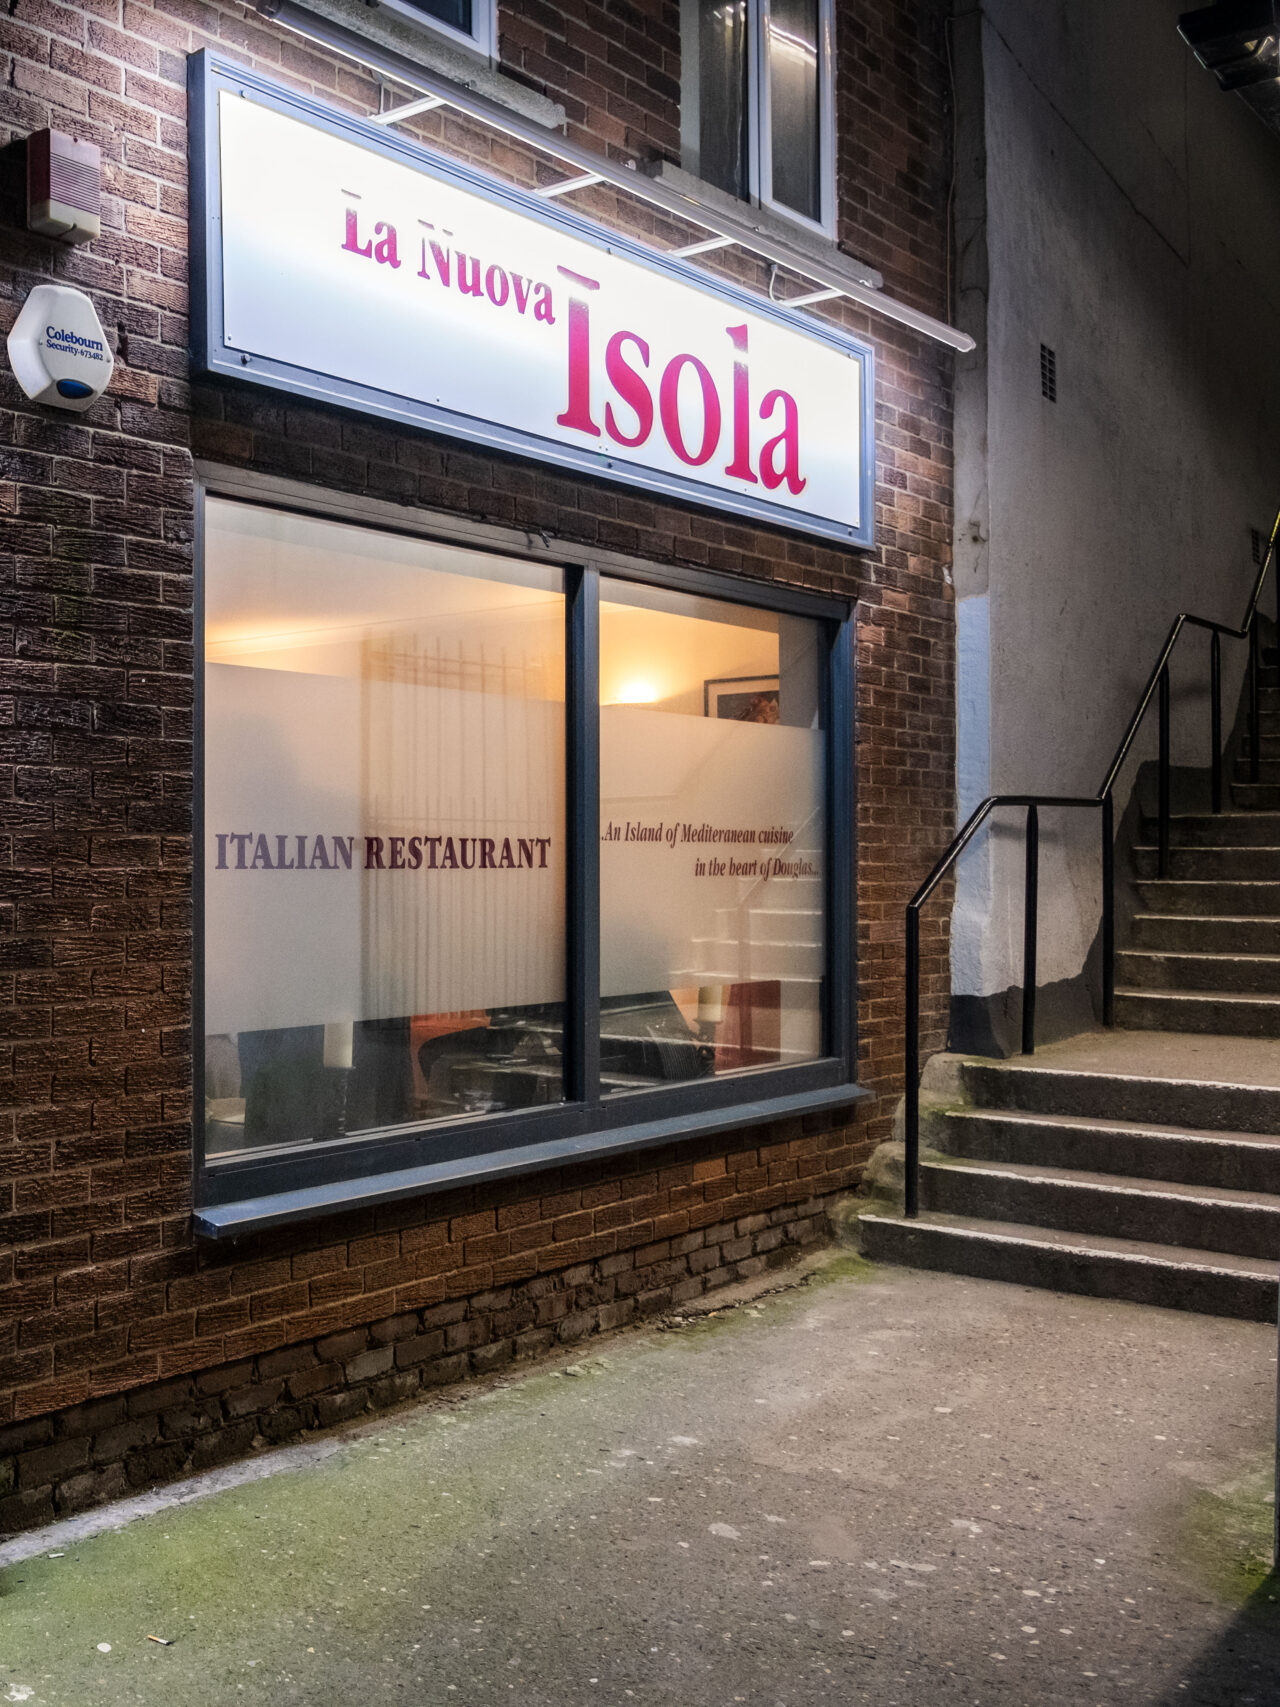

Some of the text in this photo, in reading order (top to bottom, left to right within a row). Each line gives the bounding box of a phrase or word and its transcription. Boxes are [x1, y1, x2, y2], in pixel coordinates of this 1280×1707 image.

[341, 189, 556, 325] La Nuova
[46, 326, 103, 351] Colebourn
[556, 264, 807, 496] Isola
[624, 821, 664, 842] Island
[666, 823, 680, 848] of
[681, 823, 756, 844] Mediteranean
[758, 826, 794, 845] cuisine
[215, 832, 552, 870] ITALIAN RESTAURANT
[695, 858, 706, 877] in
[708, 858, 725, 877] the
[729, 857, 757, 877] heart
[760, 857, 772, 881] of
